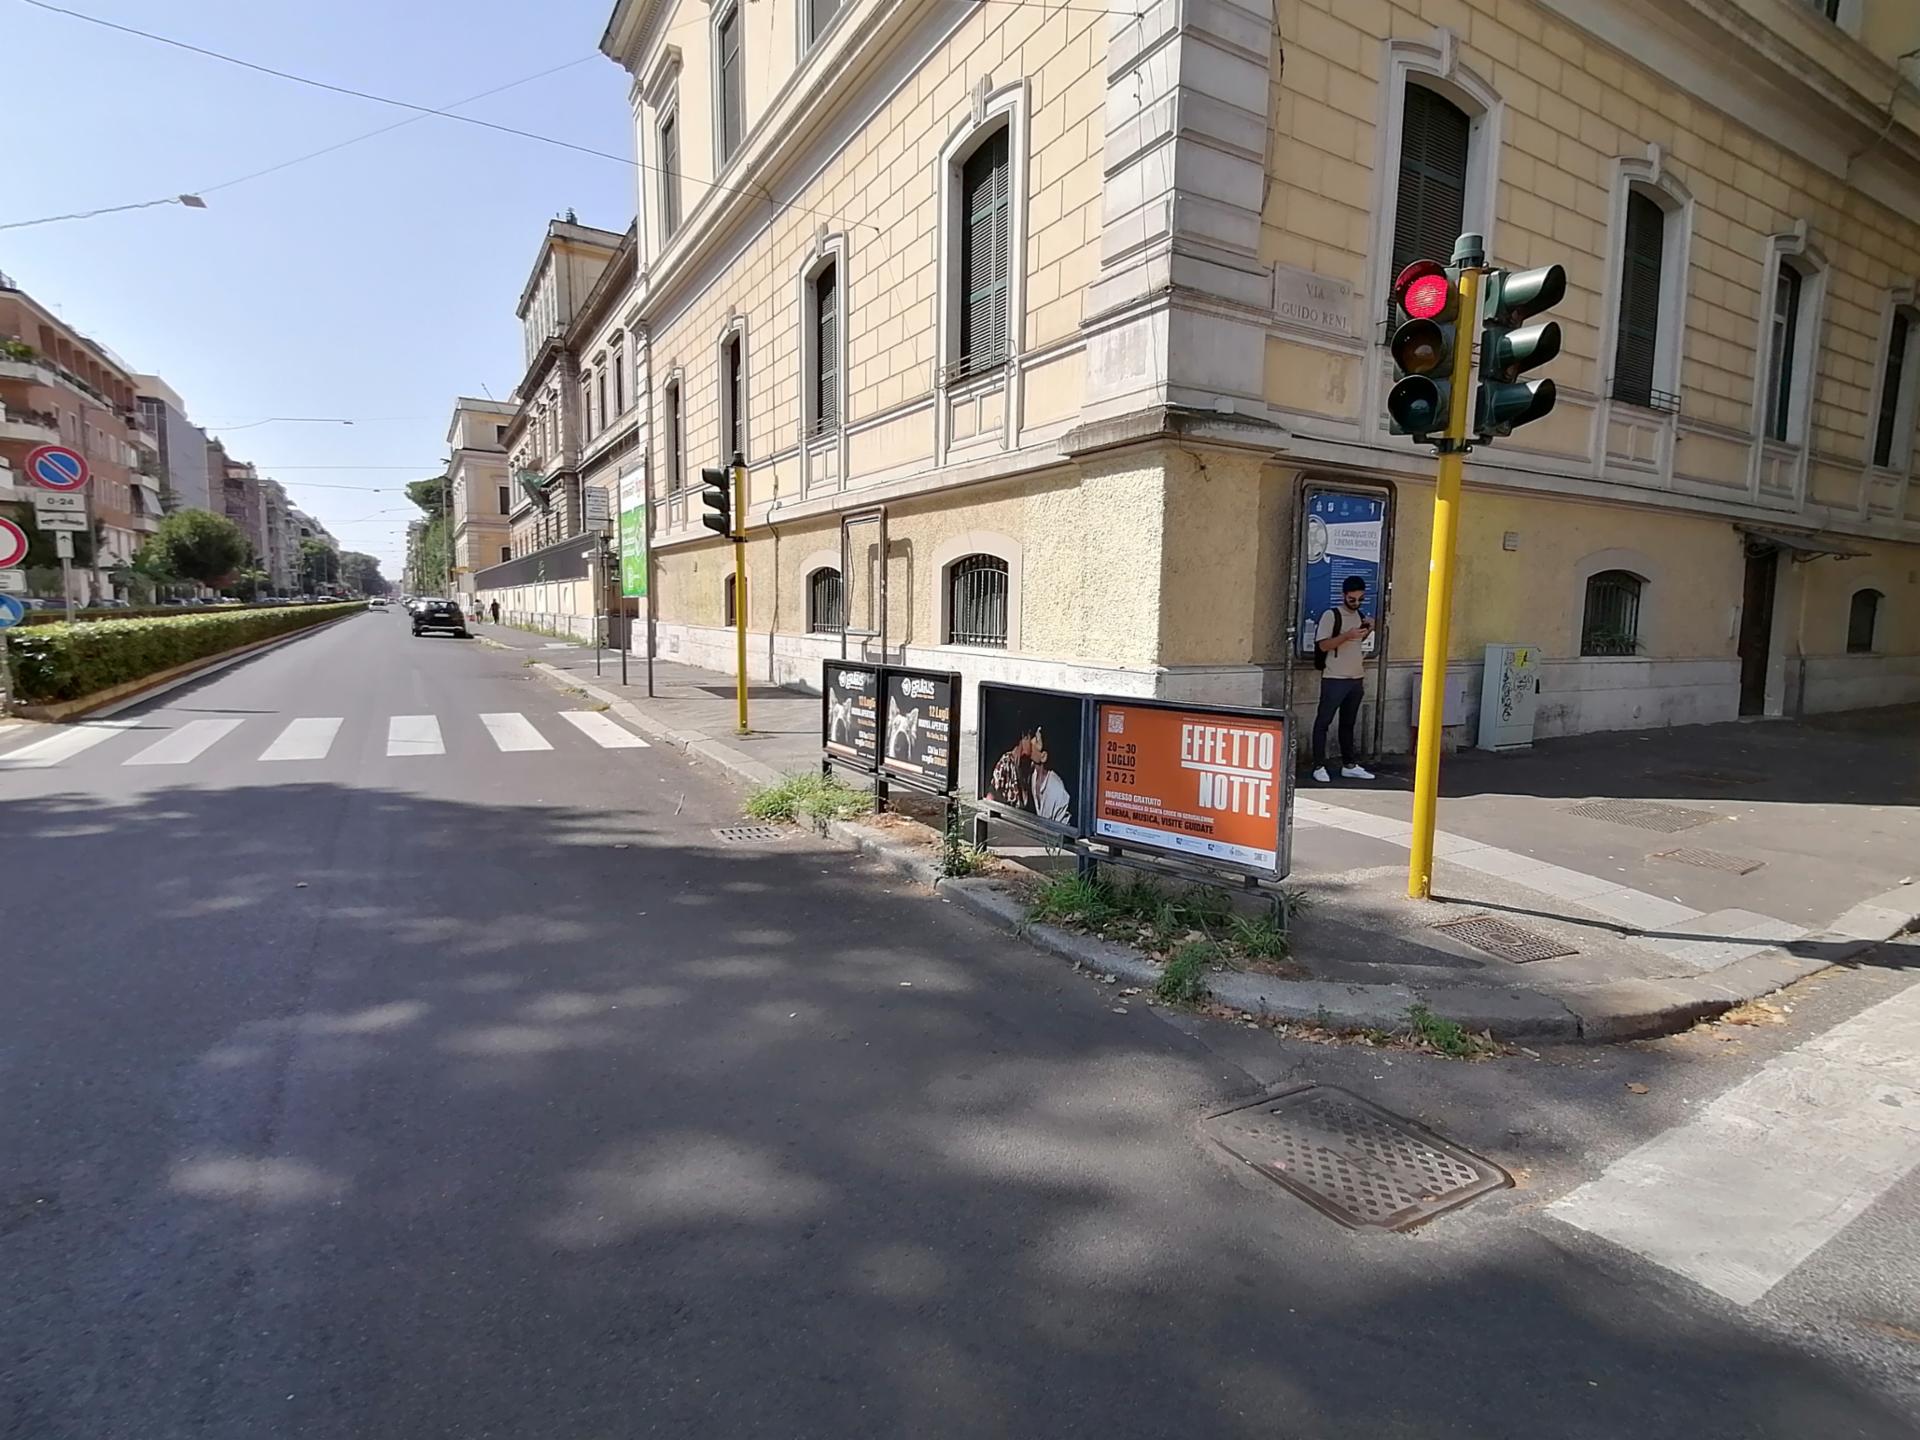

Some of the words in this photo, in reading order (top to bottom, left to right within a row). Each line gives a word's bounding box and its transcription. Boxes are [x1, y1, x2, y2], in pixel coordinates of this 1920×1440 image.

[1306, 283, 1325, 300] VIA
[1281, 302, 1319, 321] GUIDO
[1322, 311, 1346, 329] RENI
[47, 497, 74, 506] 0-24
[928, 705, 935, 716] 12
[1181, 724, 1274, 771] EFFETTO
[1106, 753, 1136, 768] LUGLIO
[1105, 770, 1136, 785] 2023
[1105, 790, 1133, 802] INGRESSO
[1133, 794, 1162, 807] GRATUITO
[1199, 771, 1272, 819] NOTTE
[1104, 807, 1131, 821] CINEMA,
[1132, 813, 1160, 826] MUSICA,
[1161, 818, 1184, 829] VISITE
[1184, 822, 1215, 835] GUIDATE
